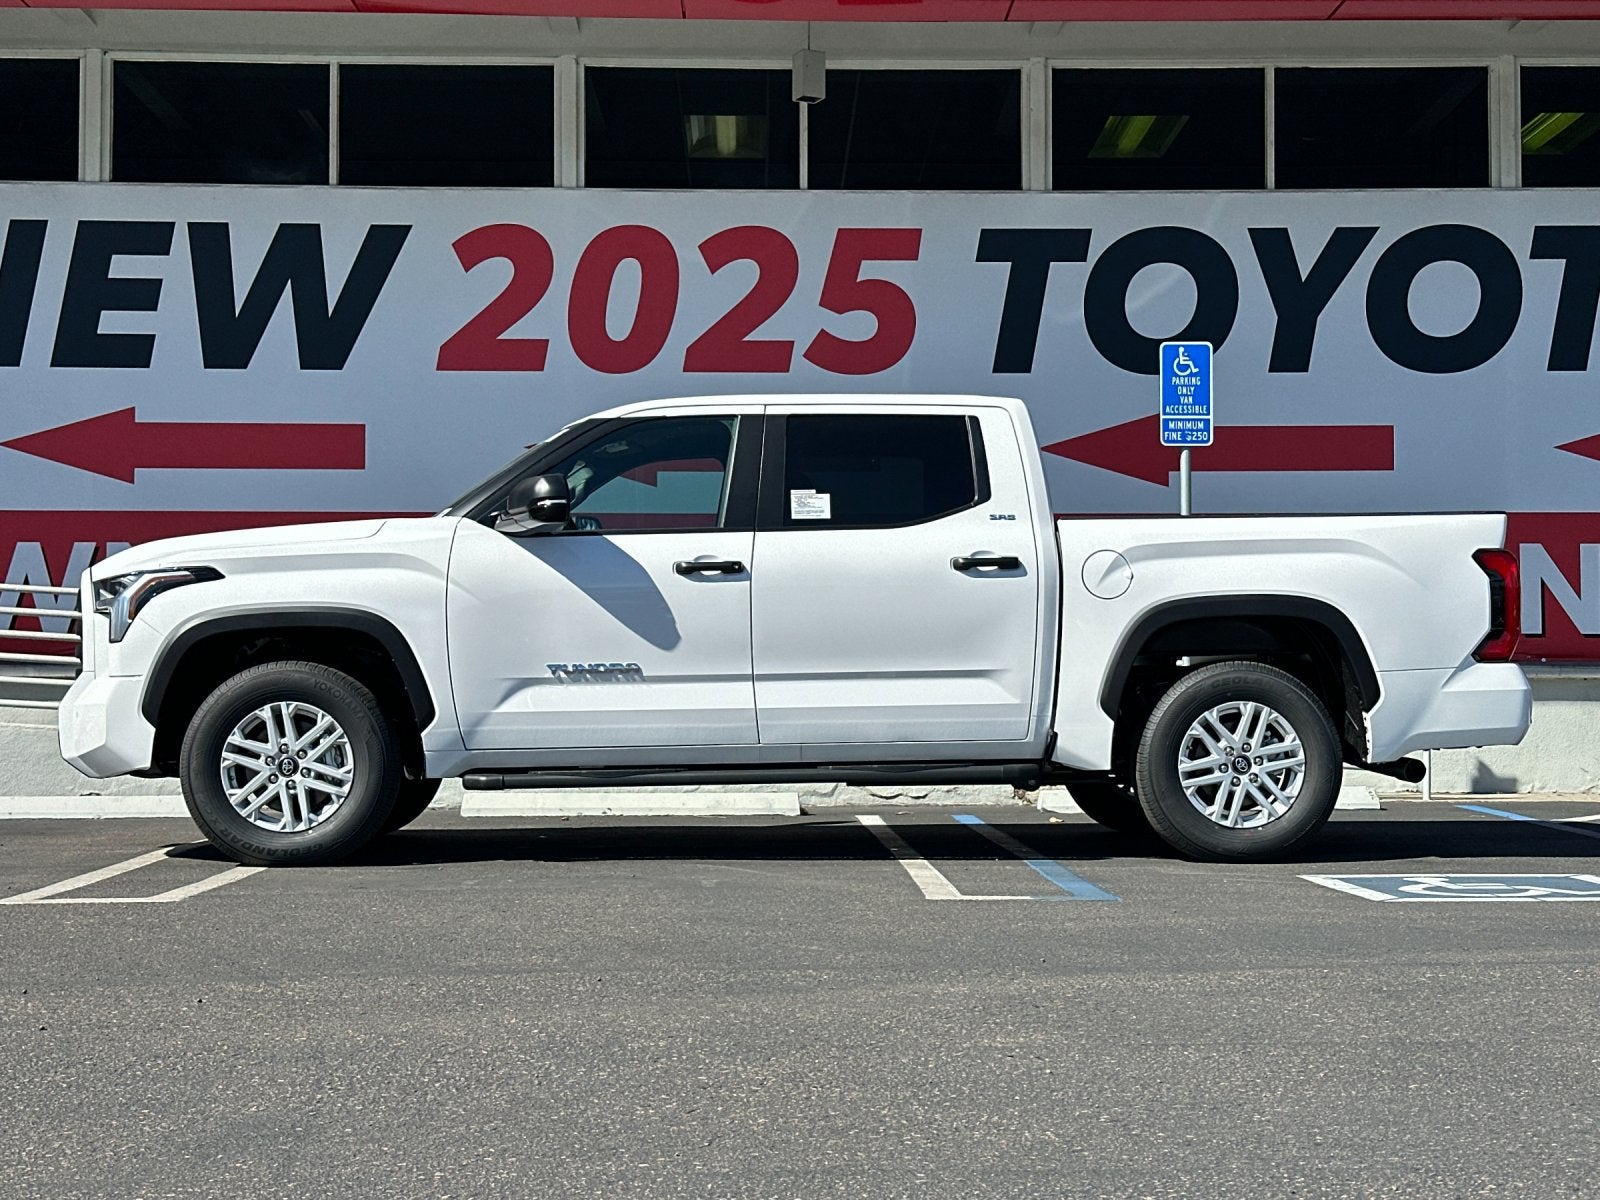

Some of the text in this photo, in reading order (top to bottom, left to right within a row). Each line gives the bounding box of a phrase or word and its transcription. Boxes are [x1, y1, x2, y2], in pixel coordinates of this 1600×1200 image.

[437, 224, 921, 375] 2025
[1172, 377, 1200, 385] PARKING
[1178, 387, 1195, 395] ONLY
[1180, 396, 1193, 404] VAN
[1166, 405, 1207, 414] ACCESSIBLE
[1169, 421, 1204, 430] MINIMUM
[1165, 432, 1182, 441] FINE
